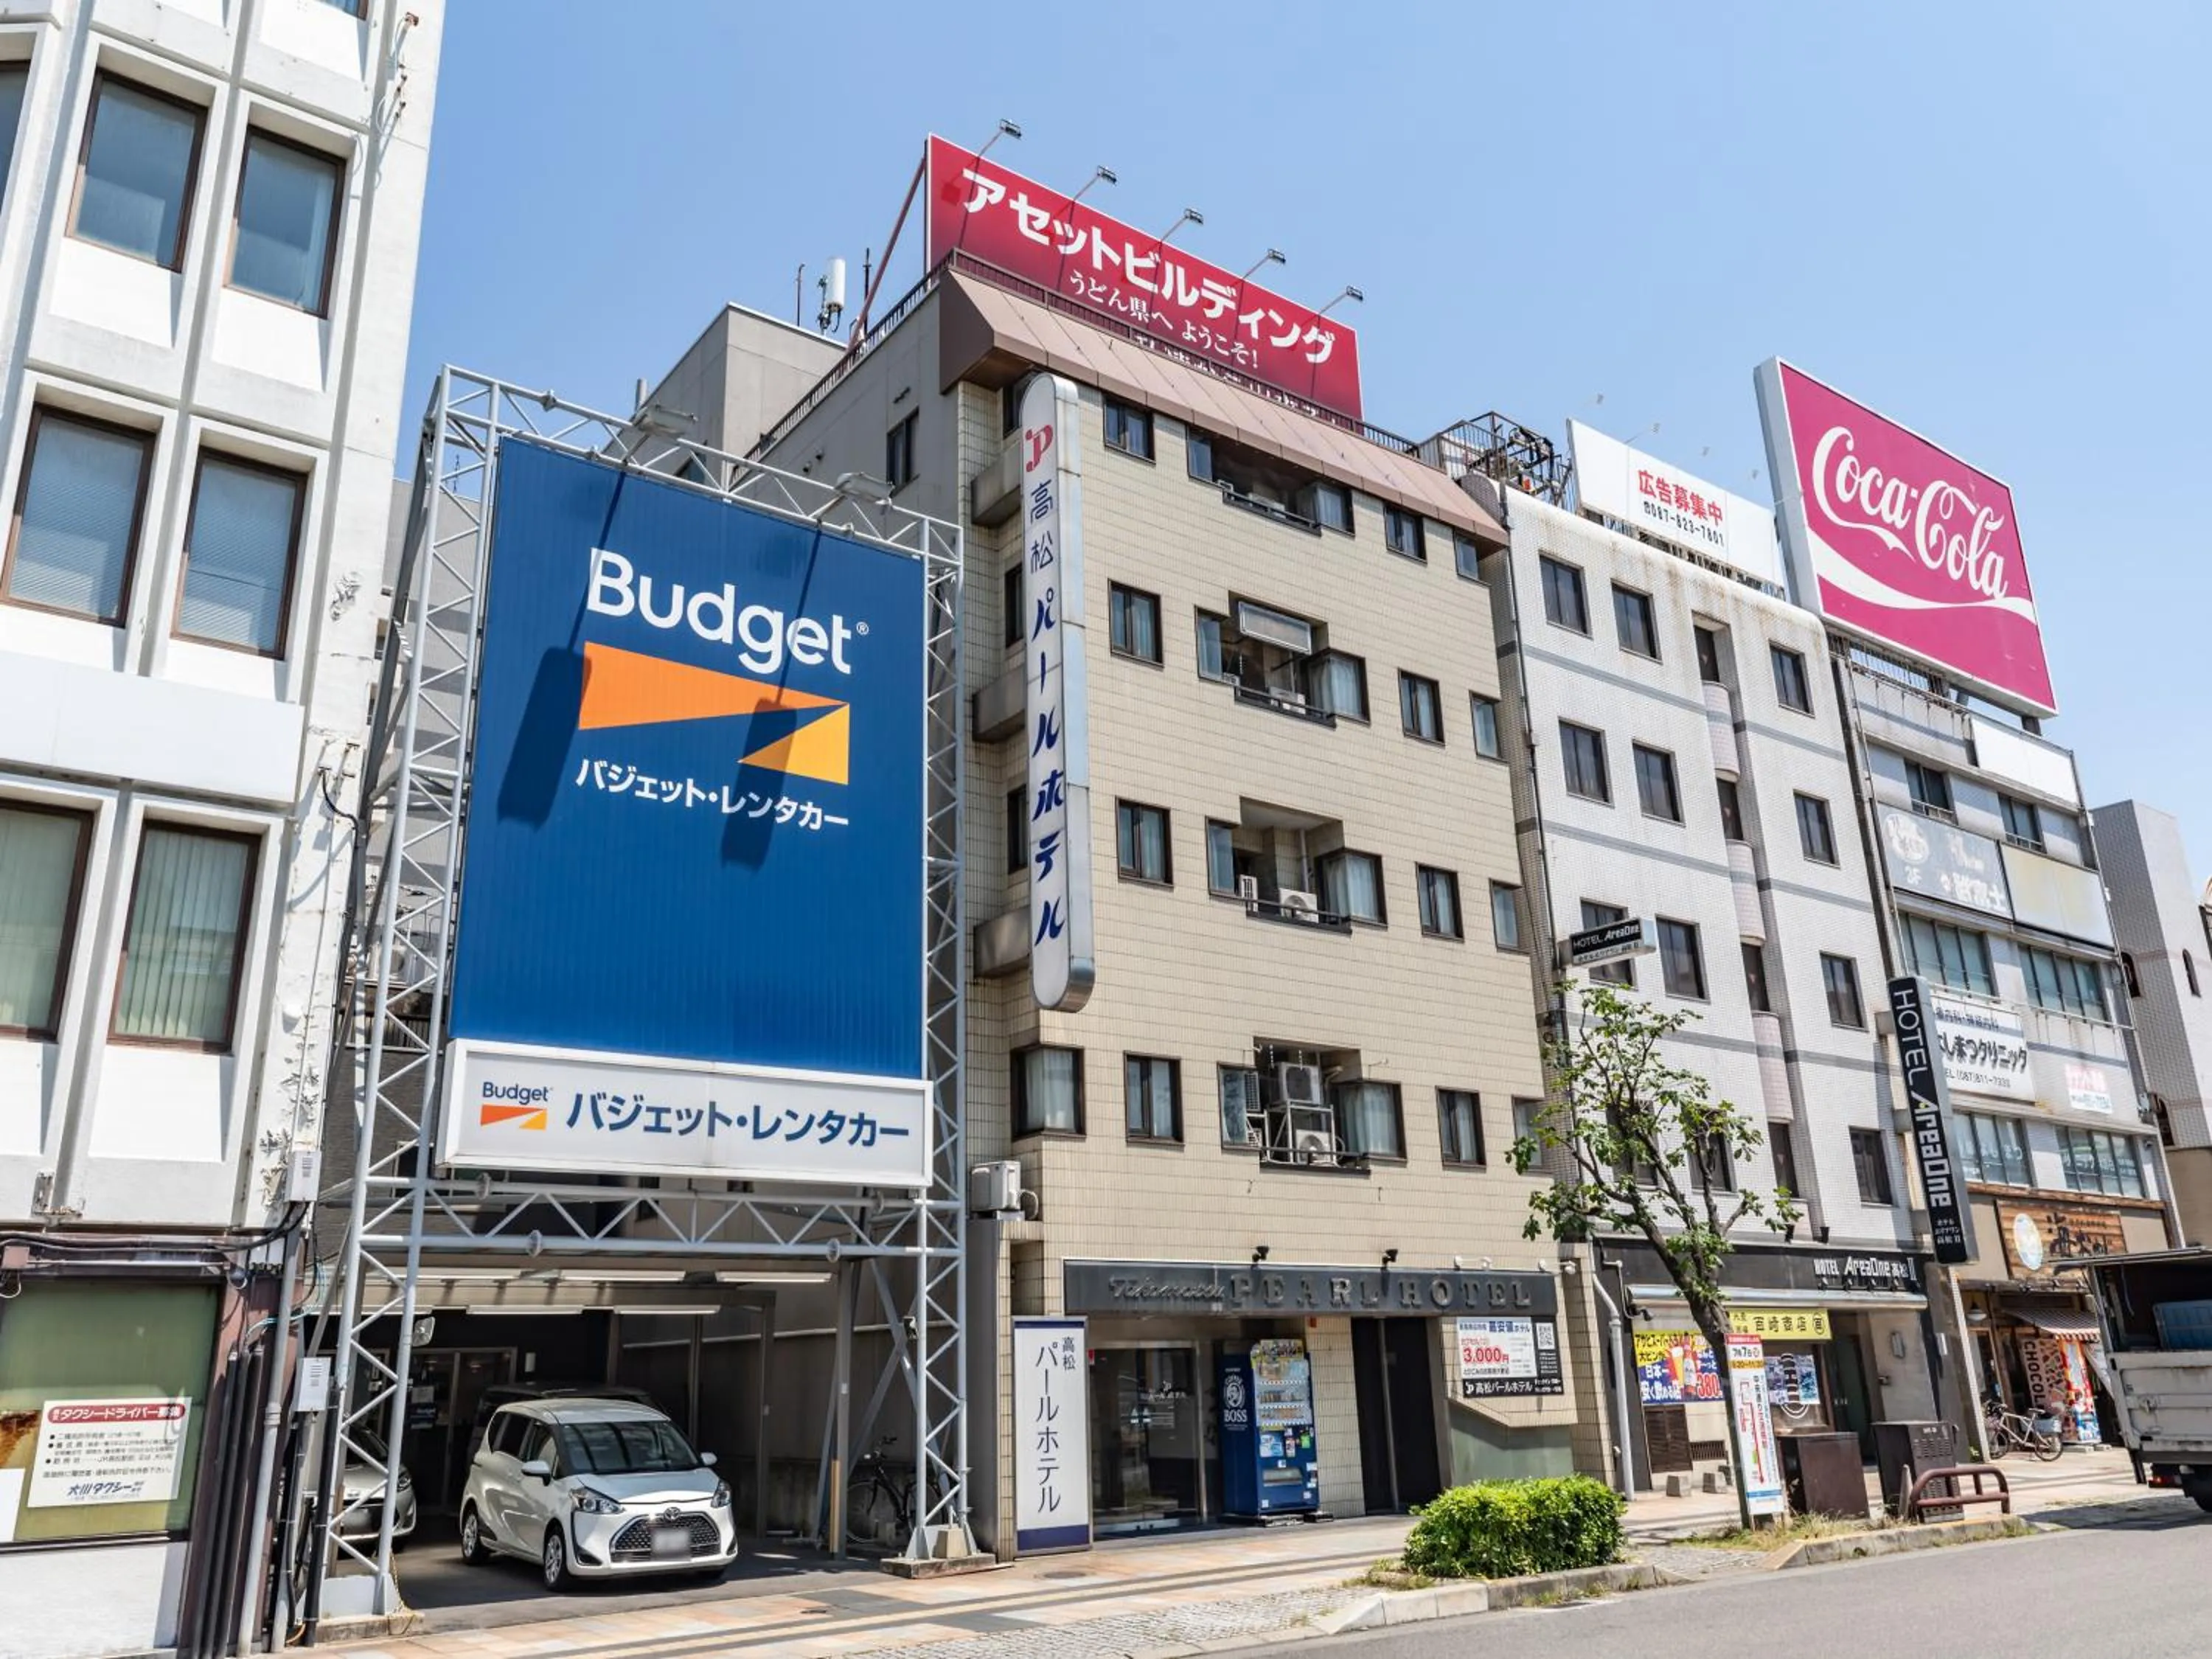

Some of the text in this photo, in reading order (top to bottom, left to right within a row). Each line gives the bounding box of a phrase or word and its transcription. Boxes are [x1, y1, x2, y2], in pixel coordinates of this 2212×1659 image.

[962, 168, 1335, 364] アセットビルディング
[1068, 270, 1175, 331] うどん県へ
[1638, 470, 1723, 526] 広告募集中
[576, 758, 849, 832] バジェット・レンタカー
[1573, 934, 1604, 949] HOTEL
[482, 1081, 549, 1105] Budget
[566, 1093, 910, 1147] バジェット・レンタカー
[1893, 988, 1953, 1208] HOTEL AreaOne
[1229, 1274, 1380, 1309] PEARL
[1399, 1277, 1532, 1310] HOTEL
[1814, 1259, 1840, 1276] HOTEL
[1844, 1256, 1891, 1277] AreaOne
[1062, 1336, 1076, 1371] 高松
[1035, 1341, 1062, 1514] パールホテル
[1223, 1409, 1248, 1422] BOSS
